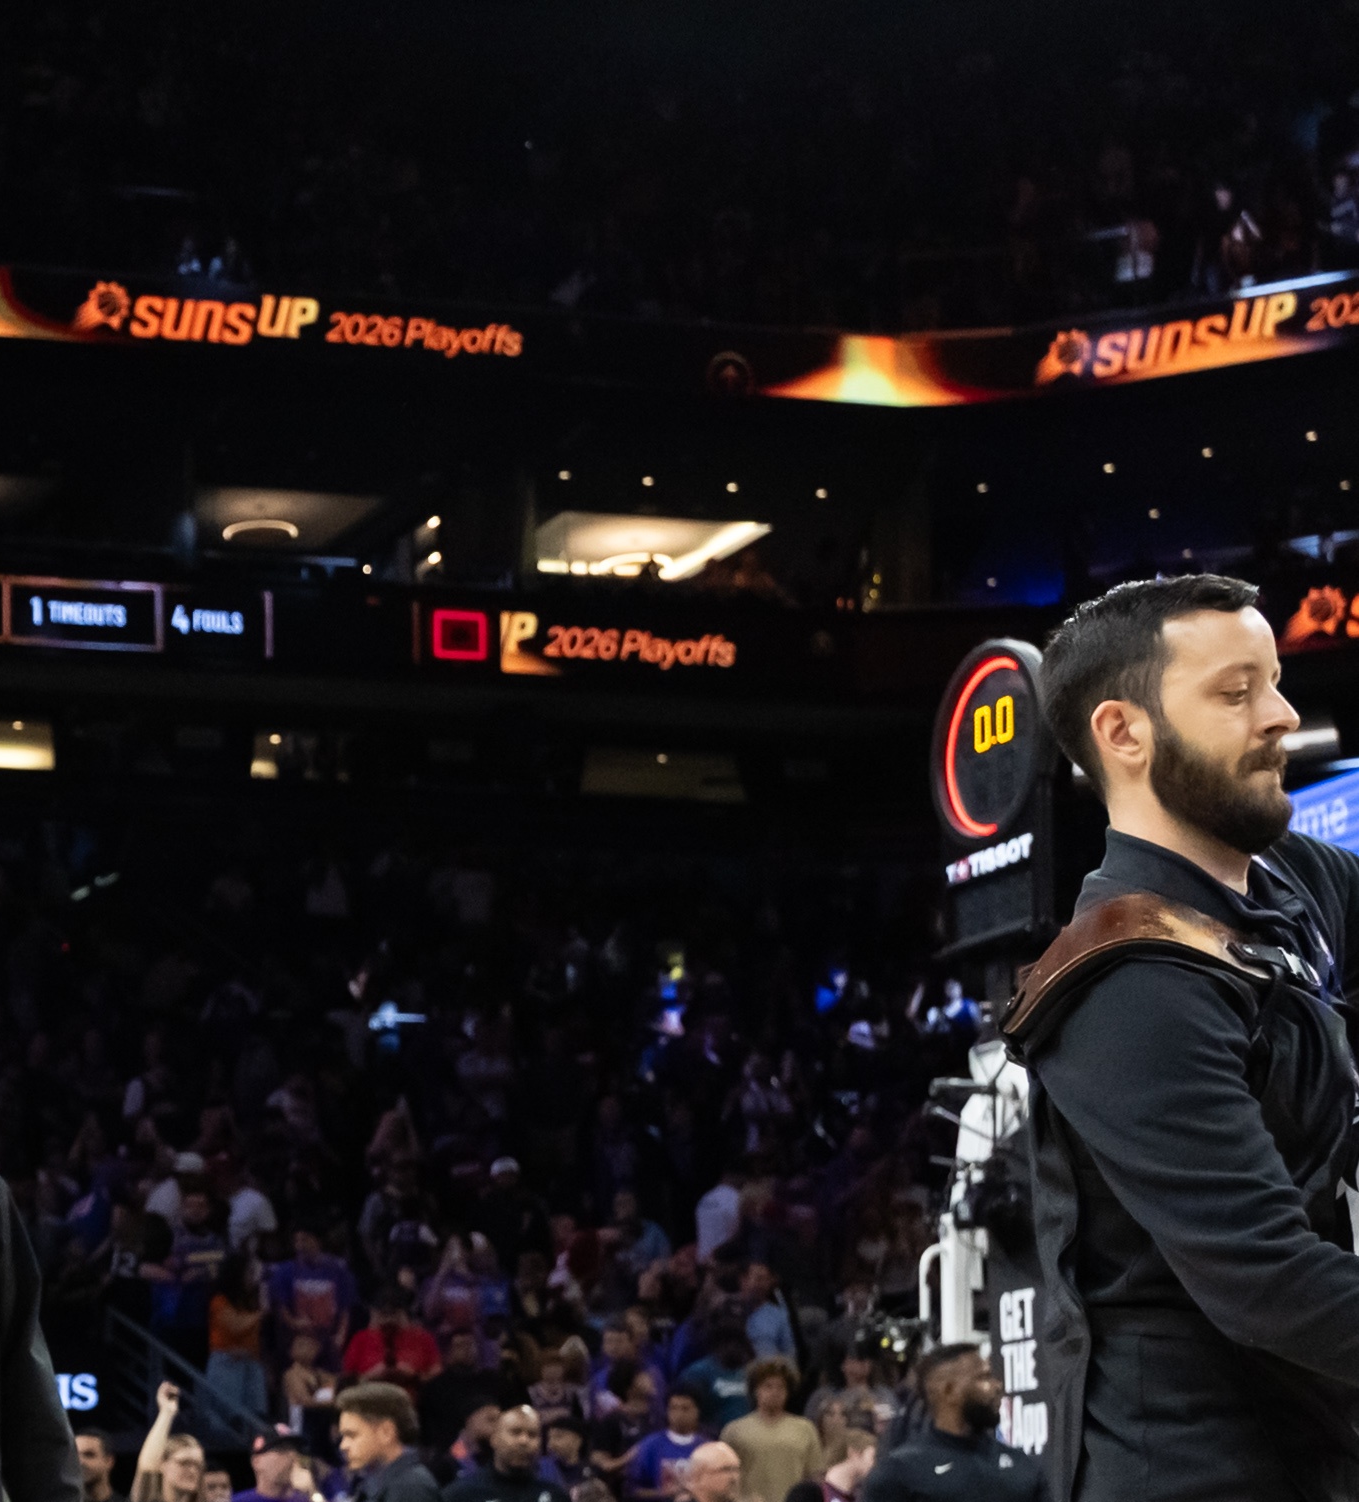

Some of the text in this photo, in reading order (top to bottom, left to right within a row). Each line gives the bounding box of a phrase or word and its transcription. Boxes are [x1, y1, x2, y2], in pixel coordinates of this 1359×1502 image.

[324, 310, 404, 348] 2026
[403, 317, 524, 358] Playoffs
[29, 596, 128, 628] 1 TIMEOUTS
[171, 604, 245, 636] 4 FOULS
[542, 624, 621, 662] 2026
[619, 629, 738, 671] Playoffs
[973, 695, 1015, 754] 0.0
[999, 1287, 1036, 1343] GET
[1000, 1339, 1039, 1394] THE
